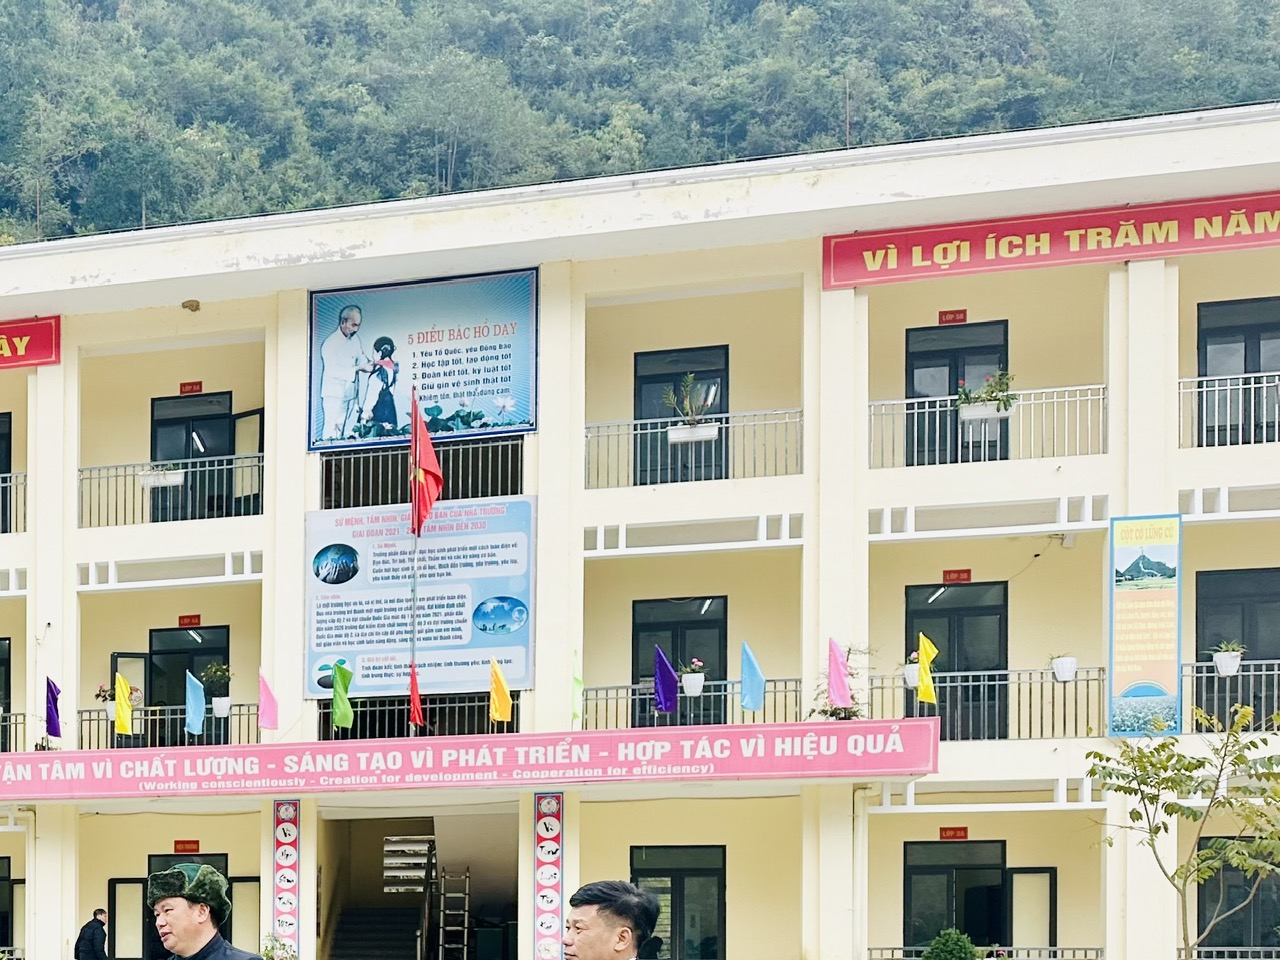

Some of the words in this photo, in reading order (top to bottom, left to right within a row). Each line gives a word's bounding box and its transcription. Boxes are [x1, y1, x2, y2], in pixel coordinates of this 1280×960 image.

[862, 243, 898, 272] VÌ
[912, 240, 970, 269] LỢI
[986, 231, 1050, 260] ÍCH
[1064, 221, 1178, 252] TRĂM
[1194, 210, 1280, 240] NĂM
[408, 334, 413, 345] 5
[417, 324, 444, 344] ĐIỀU
[448, 324, 470, 341] BÁC
[474, 318, 490, 338] HỒ
[494, 322, 517, 339] DẠY
[422, 360, 435, 369] Học
[438, 359, 449, 367] tập
[464, 378, 480, 386] sinh
[39, 760, 84, 780] TÂM
[92, 758, 112, 778] VÌ
[120, 755, 176, 778] CHẤT
[184, 756, 259, 779] LƯỢNG
[284, 751, 348, 773] SÁNG
[357, 751, 402, 773] TẠO
[410, 747, 433, 768] VÌ
[442, 745, 507, 767] PHÁT
[515, 738, 590, 765] TRIỂN
[618, 740, 671, 764] HỢP
[680, 736, 731, 760] TÁC
[740, 734, 765, 758] VÌ
[775, 733, 837, 760] HIỆU
[847, 726, 904, 756] QUẢ
[139, 780, 198, 792] (Working
[202, 777, 306, 790] conscientiously
[320, 774, 381, 785] Creation
[383, 774, 401, 783] for
[405, 771, 498, 784] development
[512, 767, 601, 780] Cooperation
[608, 766, 628, 776] for
[633, 763, 714, 776] efficiency)
